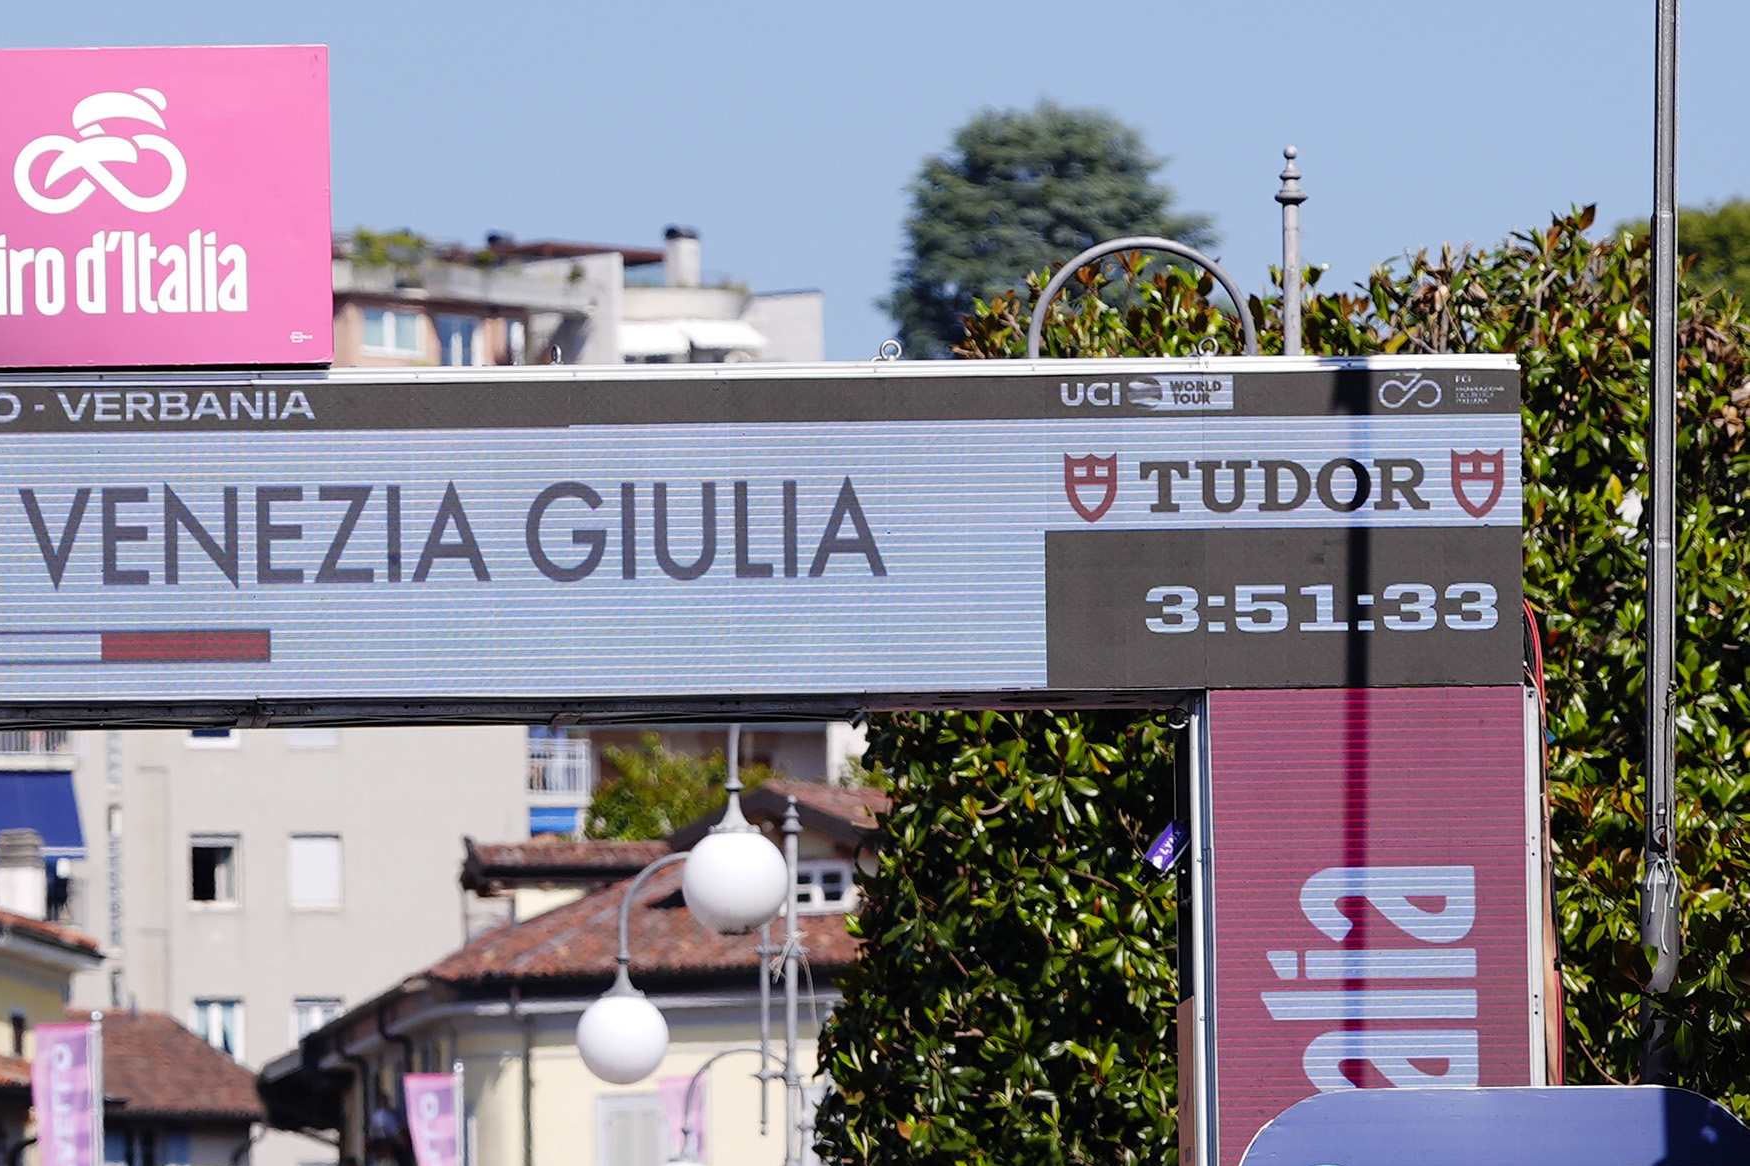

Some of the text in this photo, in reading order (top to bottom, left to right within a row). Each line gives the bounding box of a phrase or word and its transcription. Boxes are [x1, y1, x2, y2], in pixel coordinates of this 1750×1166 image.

[75, 228, 249, 315] d'Italia
[57, 390, 316, 422] VERBANIA
[1060, 382, 1120, 406] UCI
[1170, 381, 1222, 392] WORLD
[1172, 392, 1211, 404] TOUR
[1139, 457, 1431, 513] TUDOR
[18, 480, 492, 590] VENEZIA
[525, 475, 889, 583] GIULIA
[1145, 582, 1499, 633] 3:51:33
